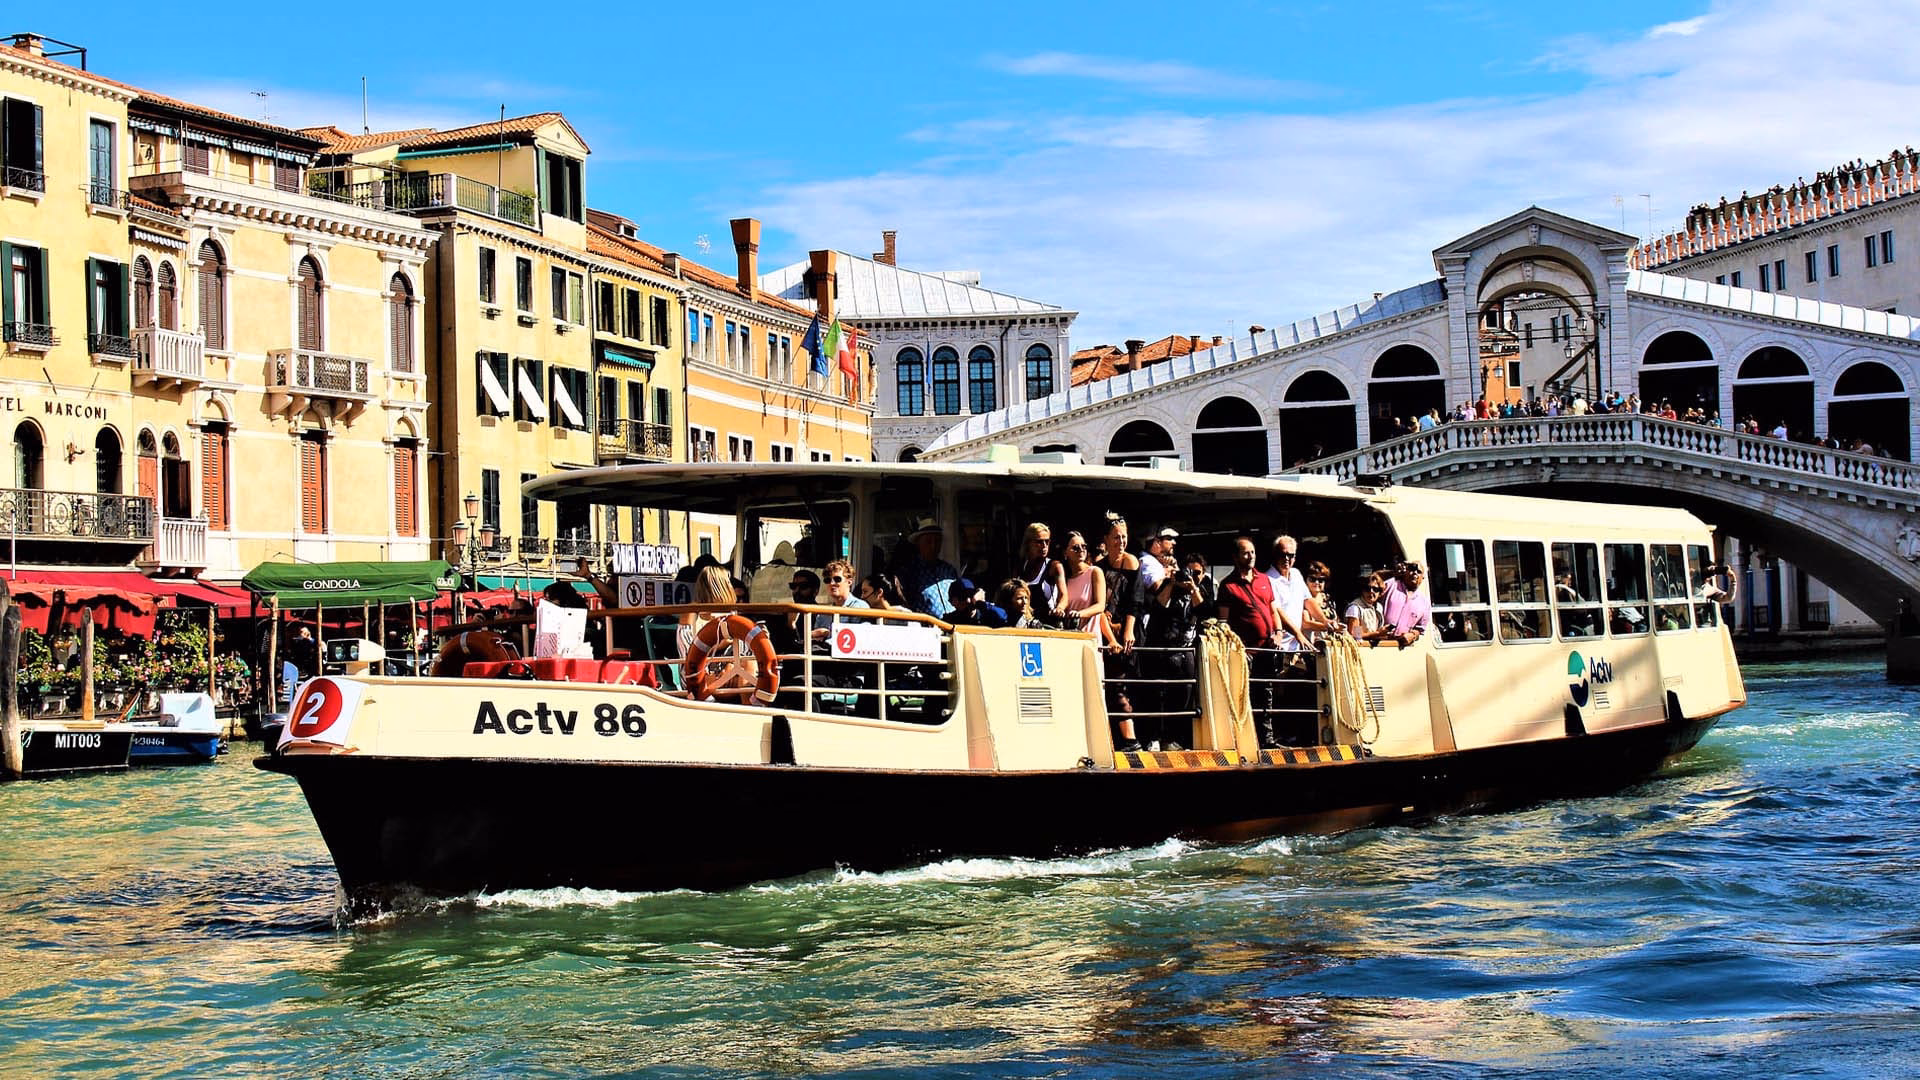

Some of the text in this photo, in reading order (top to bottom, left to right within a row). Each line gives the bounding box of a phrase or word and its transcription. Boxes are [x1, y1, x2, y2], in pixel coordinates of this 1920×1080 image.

[45, 401, 107, 420] MARCONI
[303, 579, 361, 590] GONDOLA
[842, 633, 851, 649] 2
[1590, 656, 1613, 684] Actv
[299, 692, 325, 725] 2
[473, 701, 647, 738] Actv 86
[55, 733, 101, 749] MIT003
